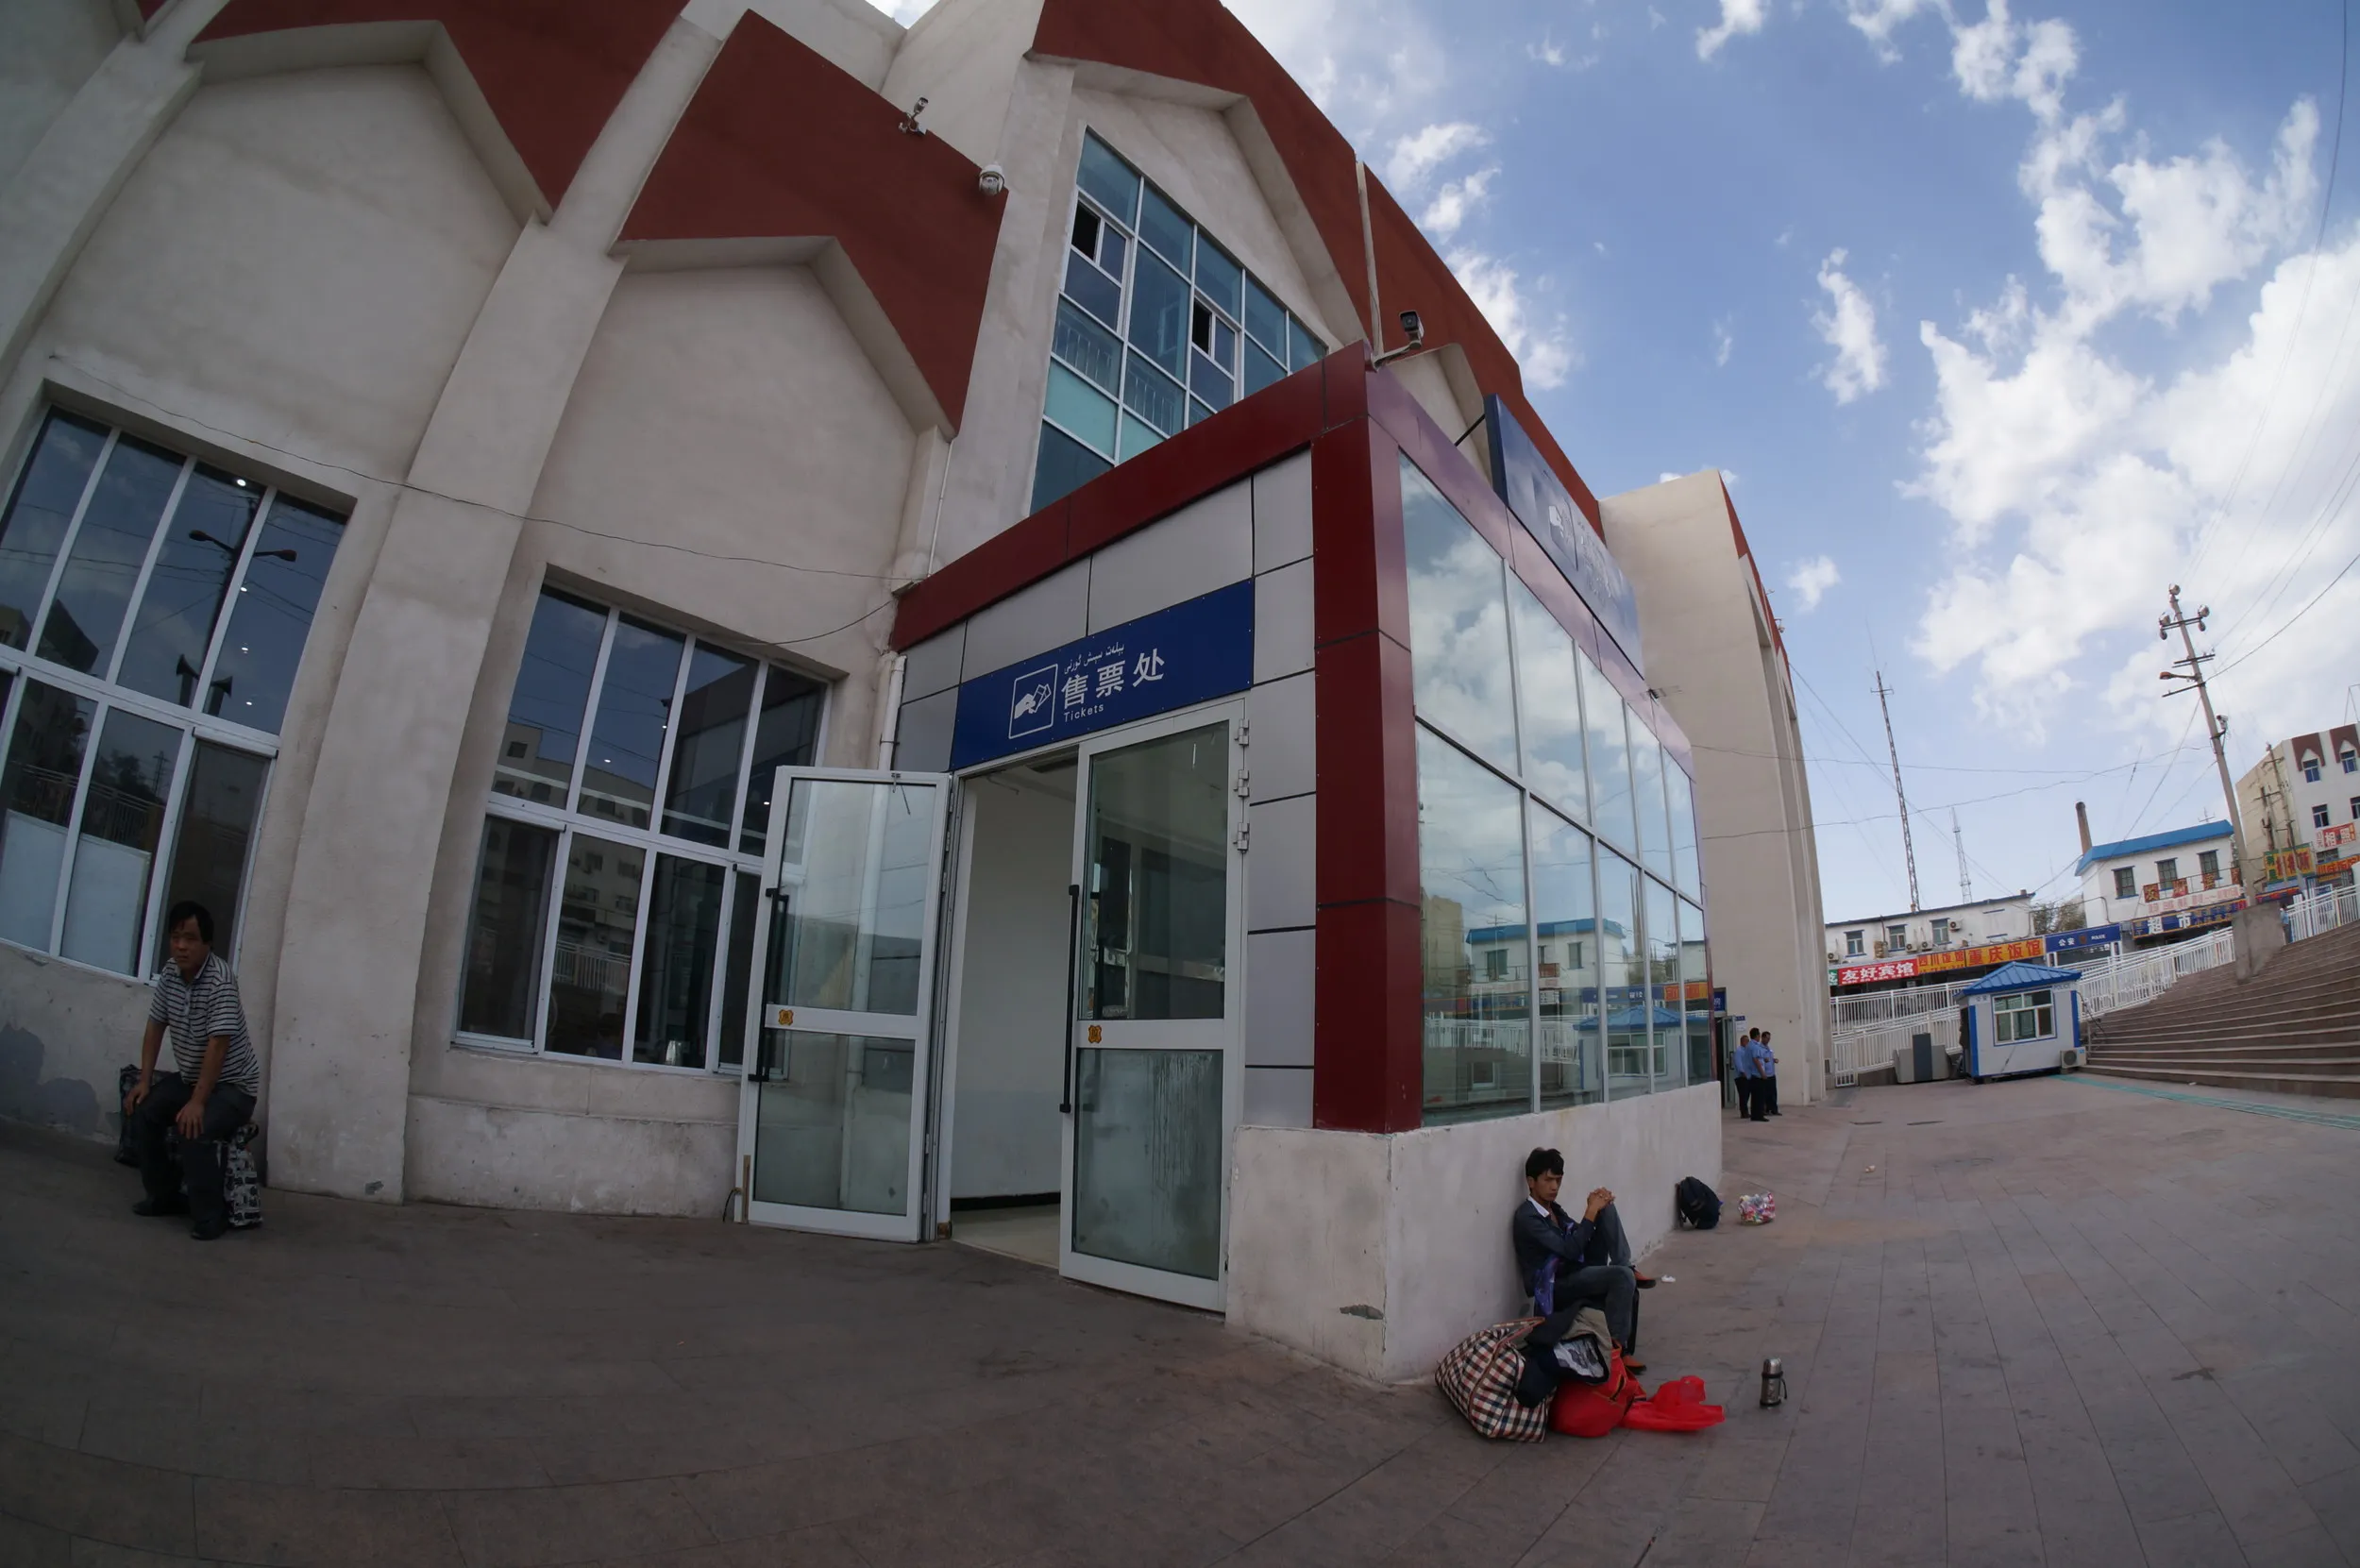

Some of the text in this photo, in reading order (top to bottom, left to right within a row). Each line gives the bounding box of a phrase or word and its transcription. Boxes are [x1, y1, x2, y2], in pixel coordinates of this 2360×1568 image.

[1061, 648, 1165, 710] 售票处
[1063, 703, 1104, 722] Tickets
[2148, 911, 2192, 935] 超市
[1968, 939, 2041, 966] 重庆饭馆
[1842, 962, 1913, 981] 友好宾馆
